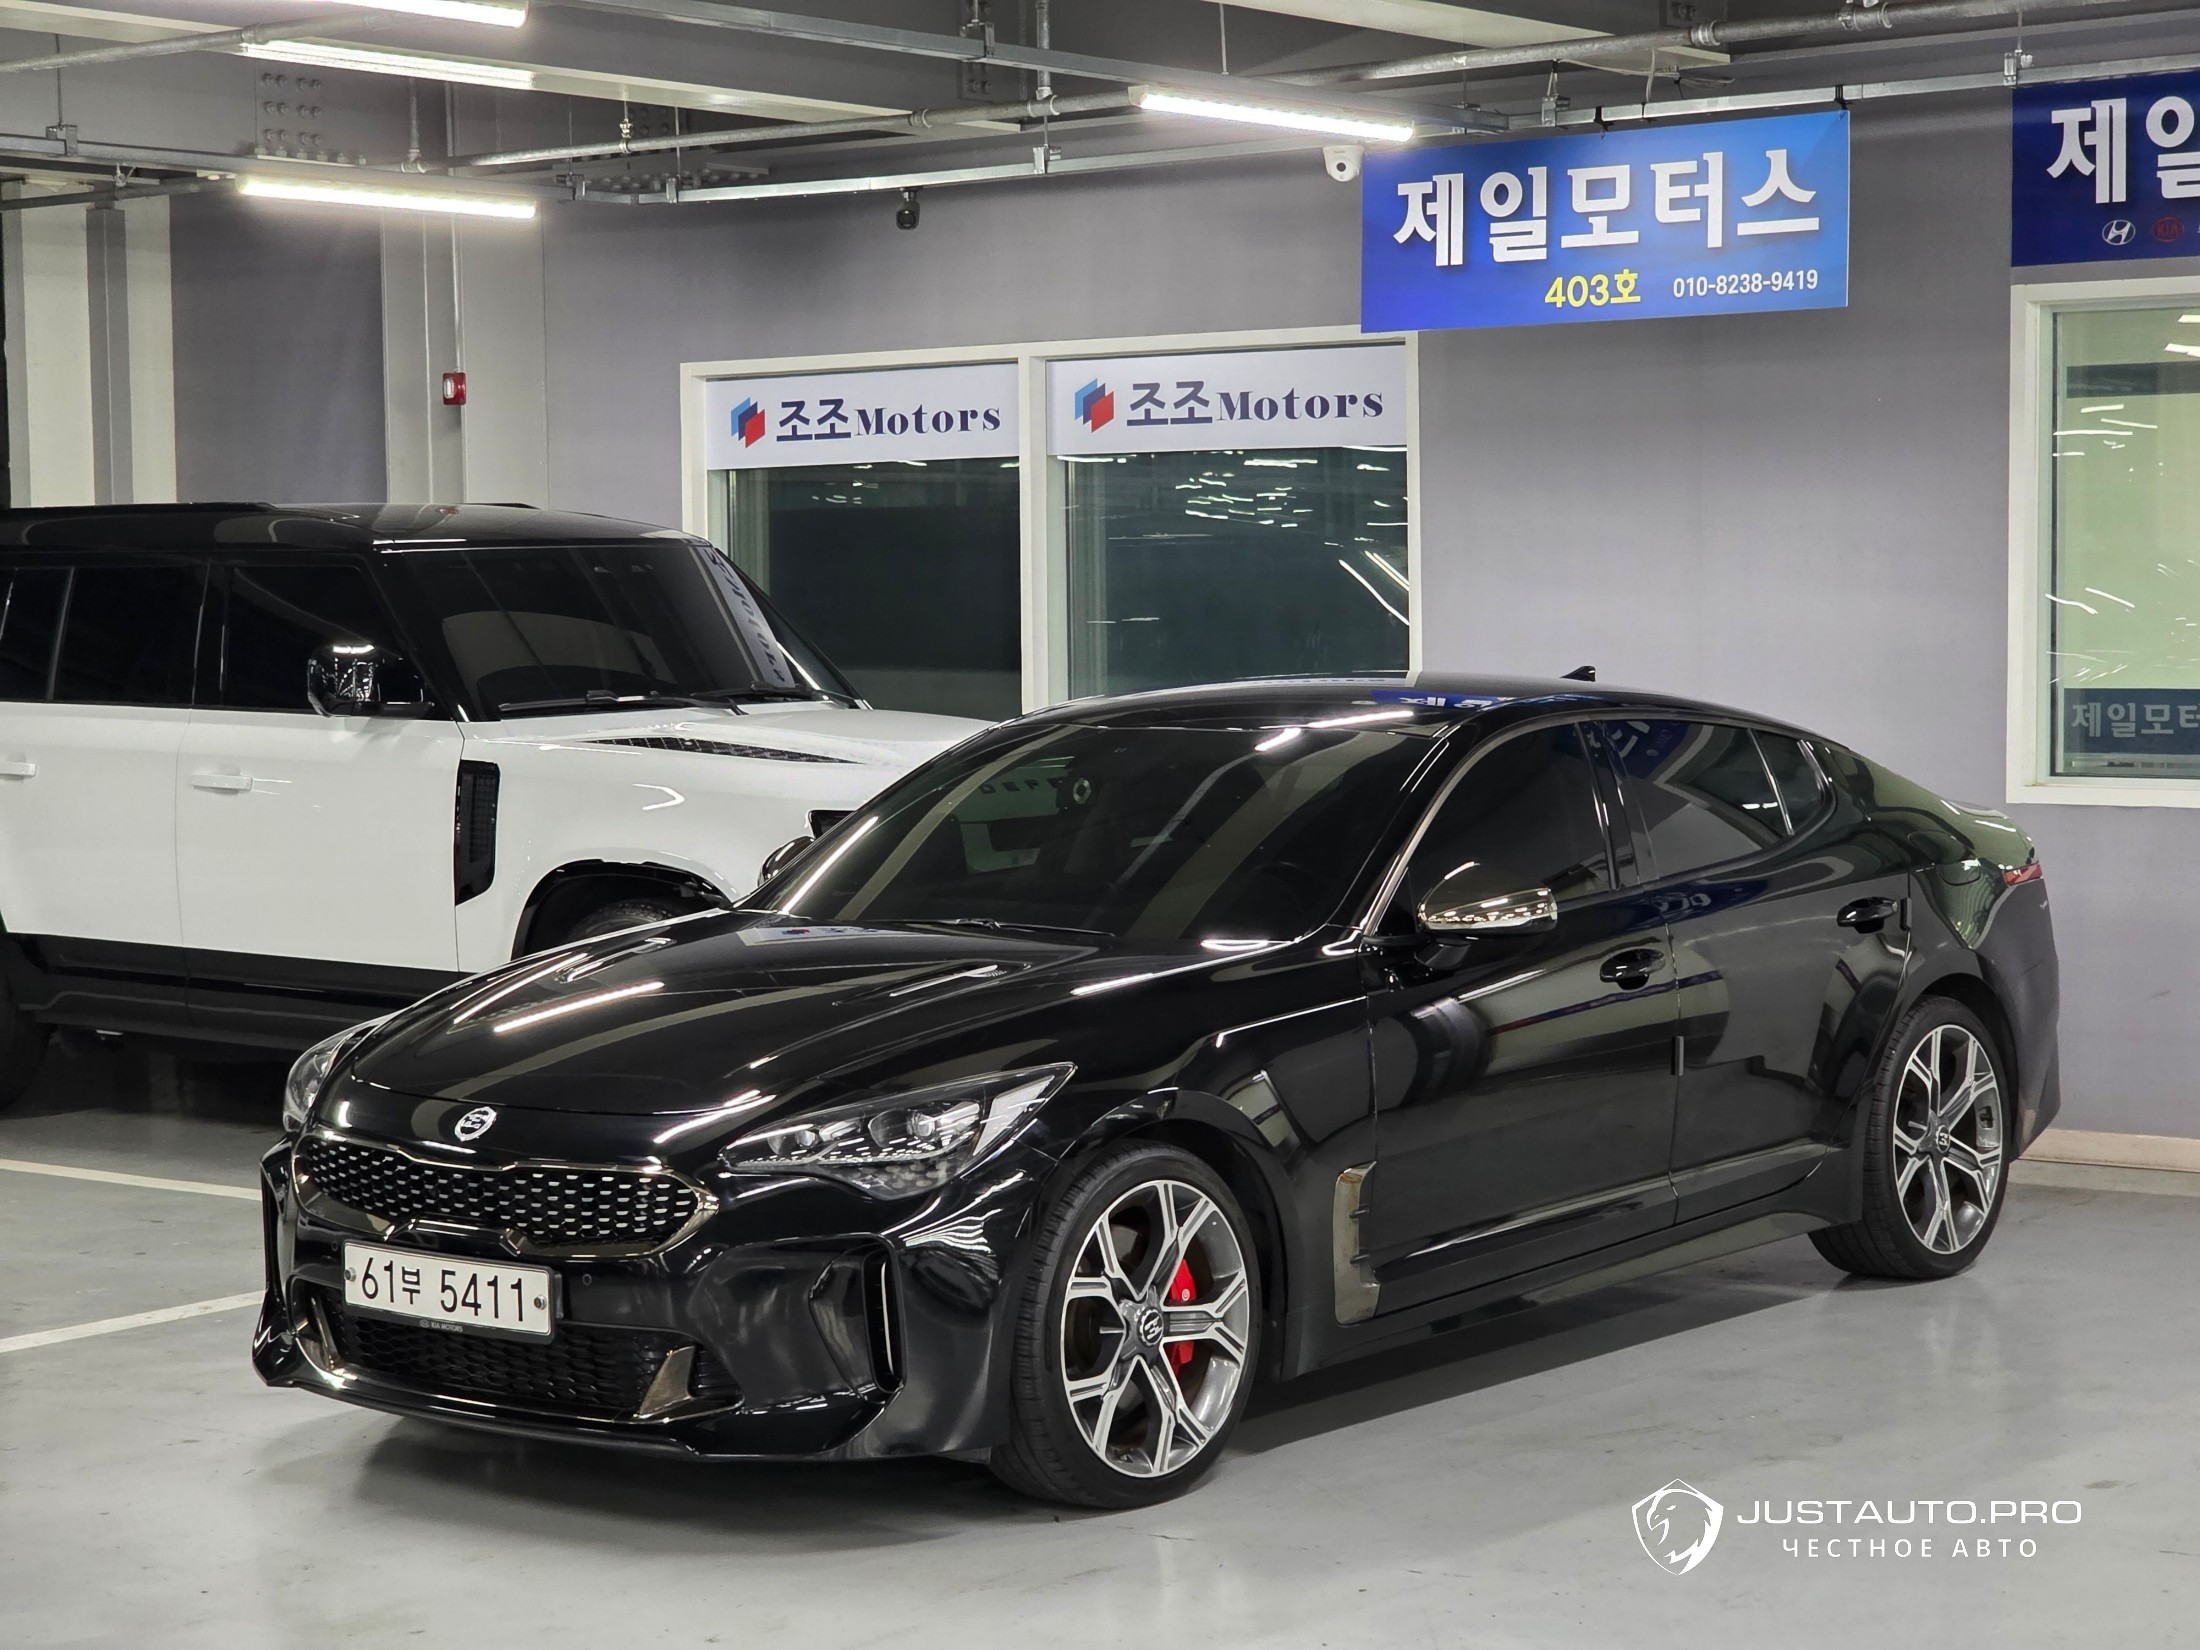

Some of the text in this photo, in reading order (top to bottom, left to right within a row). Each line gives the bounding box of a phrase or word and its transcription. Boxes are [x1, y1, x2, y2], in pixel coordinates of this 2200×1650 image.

[1393, 148, 1820, 266] 제일모터스
[1544, 268, 1819, 308] 403호 010-8238-9419
[362, 1257, 524, 1322] 61부 5411
